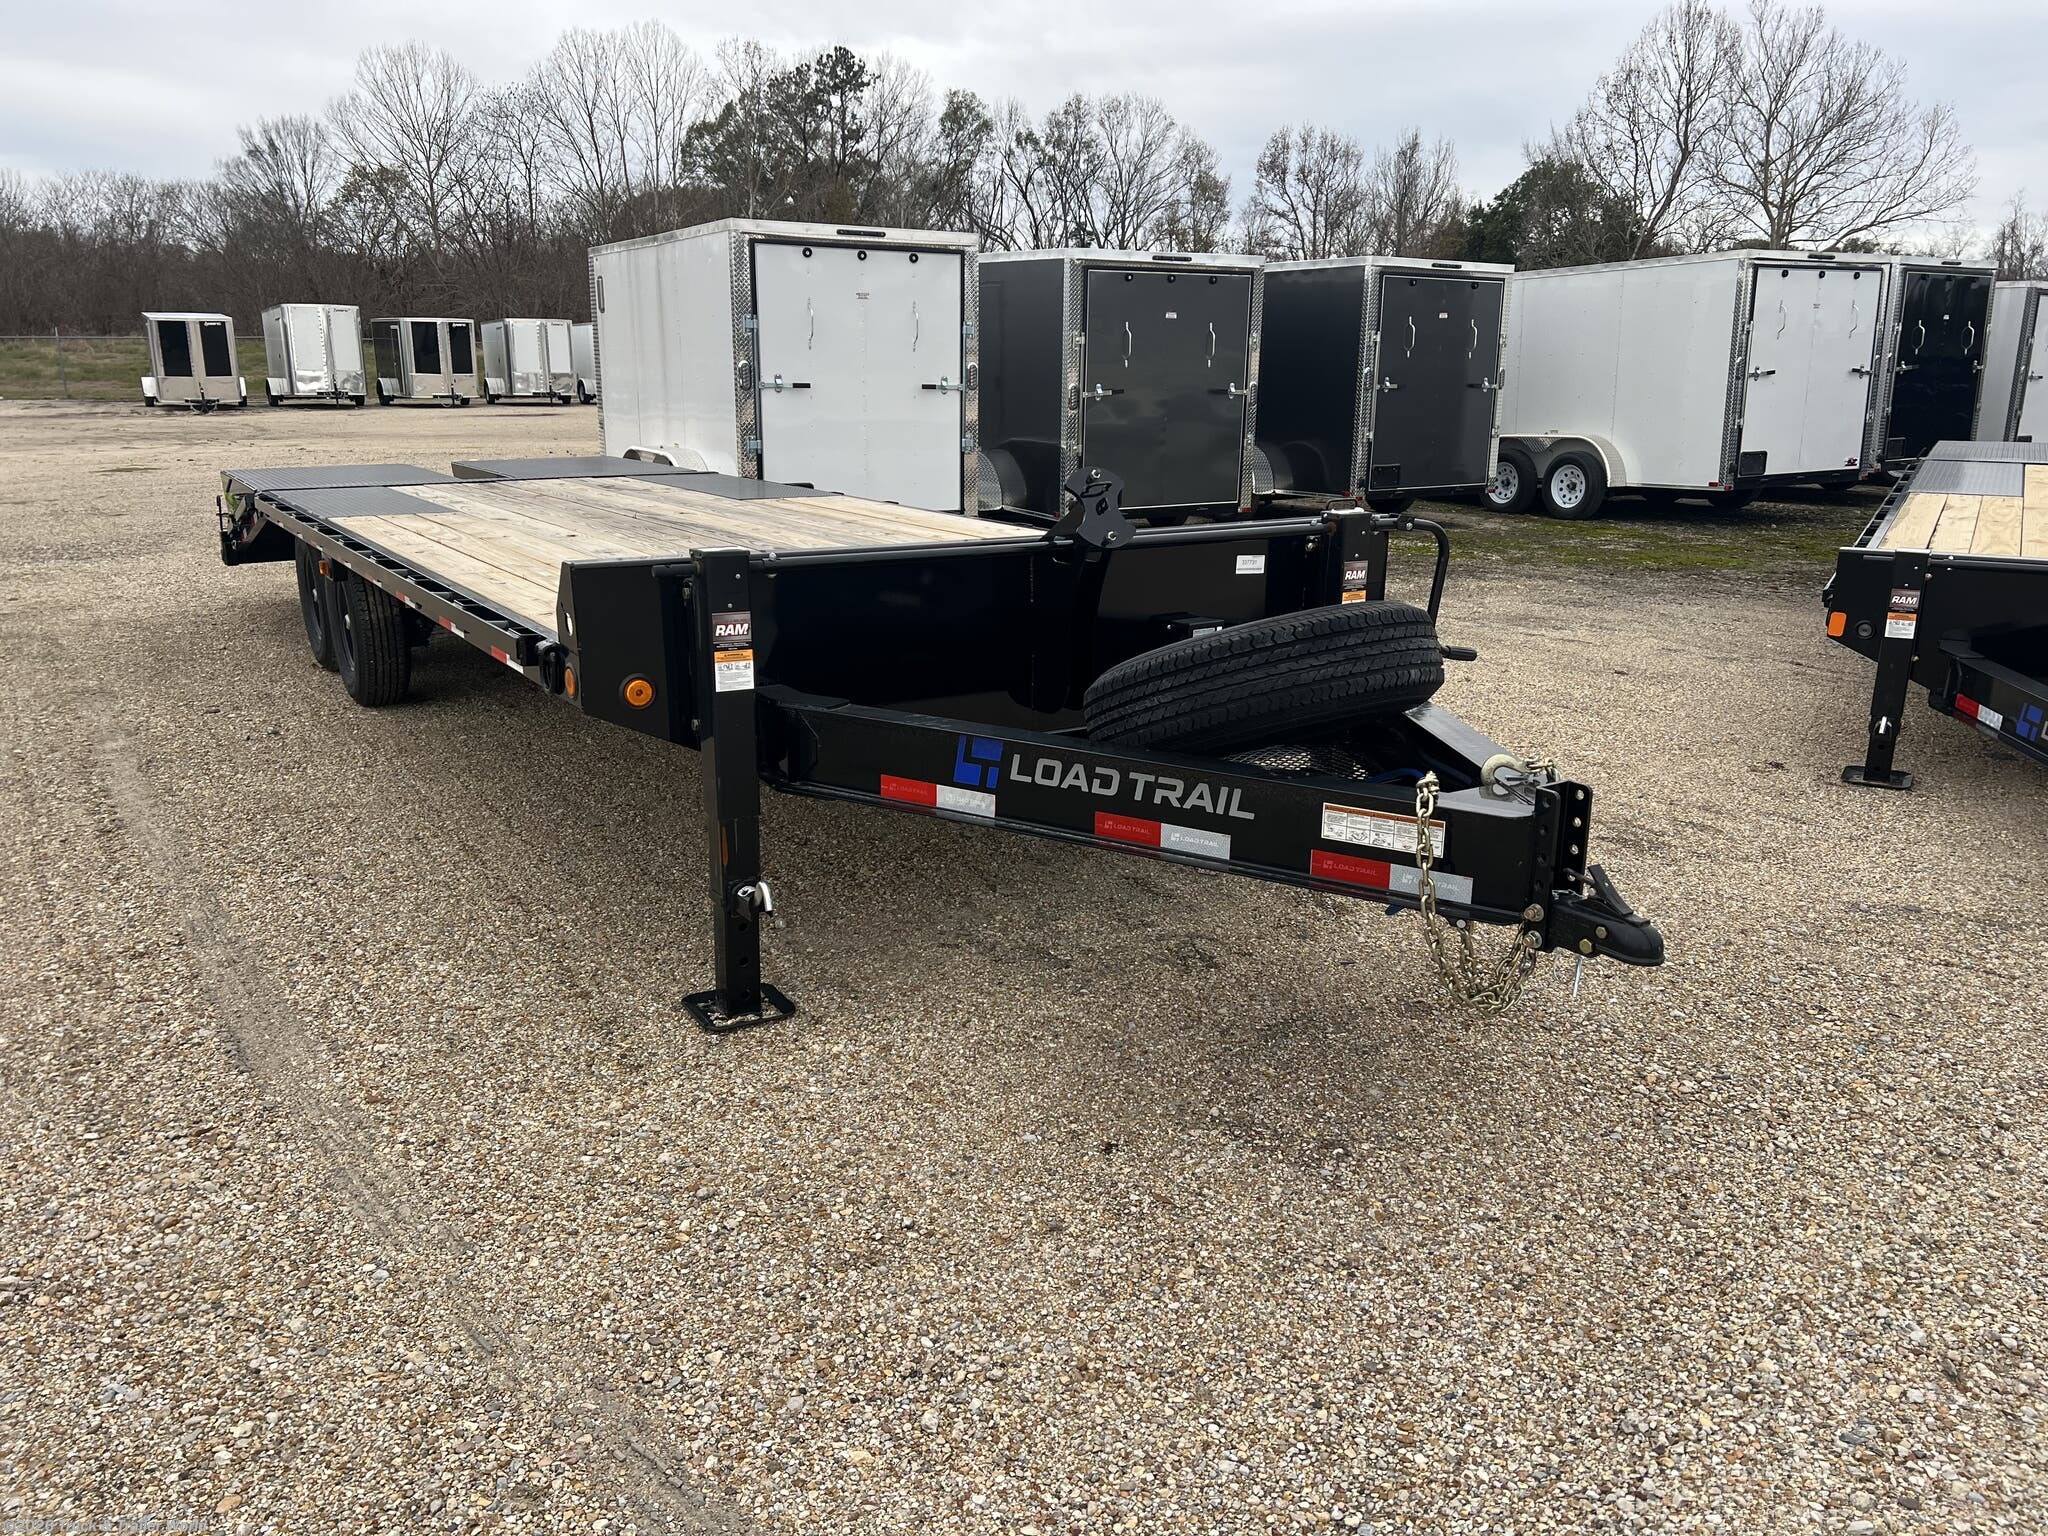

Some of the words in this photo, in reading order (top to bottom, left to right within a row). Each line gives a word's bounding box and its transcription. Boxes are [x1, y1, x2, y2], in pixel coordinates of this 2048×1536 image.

[1345, 570, 1366, 580] RAM
[1892, 595, 1917, 605] RAM
[715, 623, 749, 636] RAM
[1009, 753, 1121, 797] LOAD
[1129, 771, 1256, 820] TRAIL
[1113, 823, 1132, 832] LOAD
[1132, 826, 1150, 835] TRAIL
[1180, 835, 1200, 844] LOAD
[1199, 839, 1220, 848] TRAIL
[1333, 863, 1355, 872] LOAD
[1355, 866, 1377, 876] TRAIL
